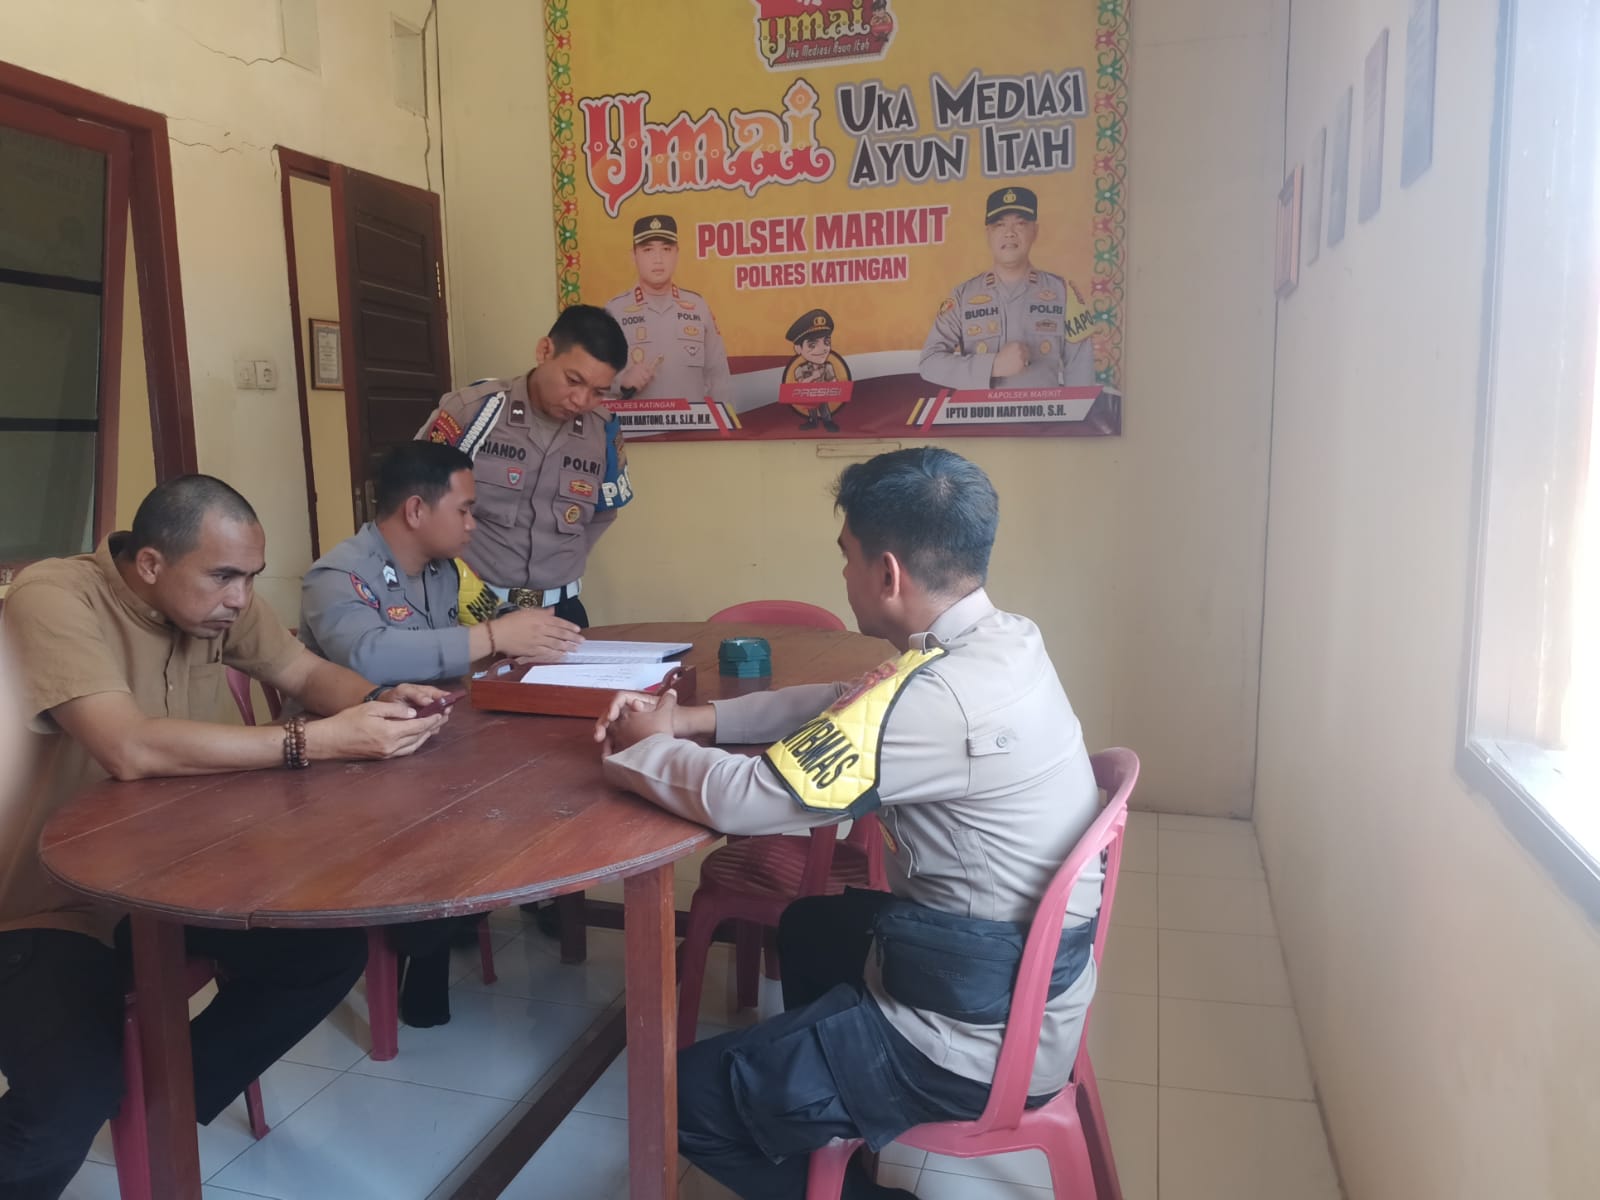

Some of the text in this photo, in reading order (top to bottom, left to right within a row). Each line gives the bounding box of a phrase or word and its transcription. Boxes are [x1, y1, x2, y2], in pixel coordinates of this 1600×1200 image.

[852, 133, 964, 184] AYUN
[697, 206, 949, 258] POLSEK MARIKIT
[736, 256, 907, 289] POLRES KATINGAN
[1029, 304, 1063, 315] POLRI
[622, 315, 646, 326] DODIK
[987, 390, 1062, 400] KAPOLSEK MARIKIT
[639, 401, 676, 409] KATINGAN
[946, 406, 968, 419] IPTU
[970, 406, 995, 418] BUDI
[563, 455, 601, 476] POLRI
